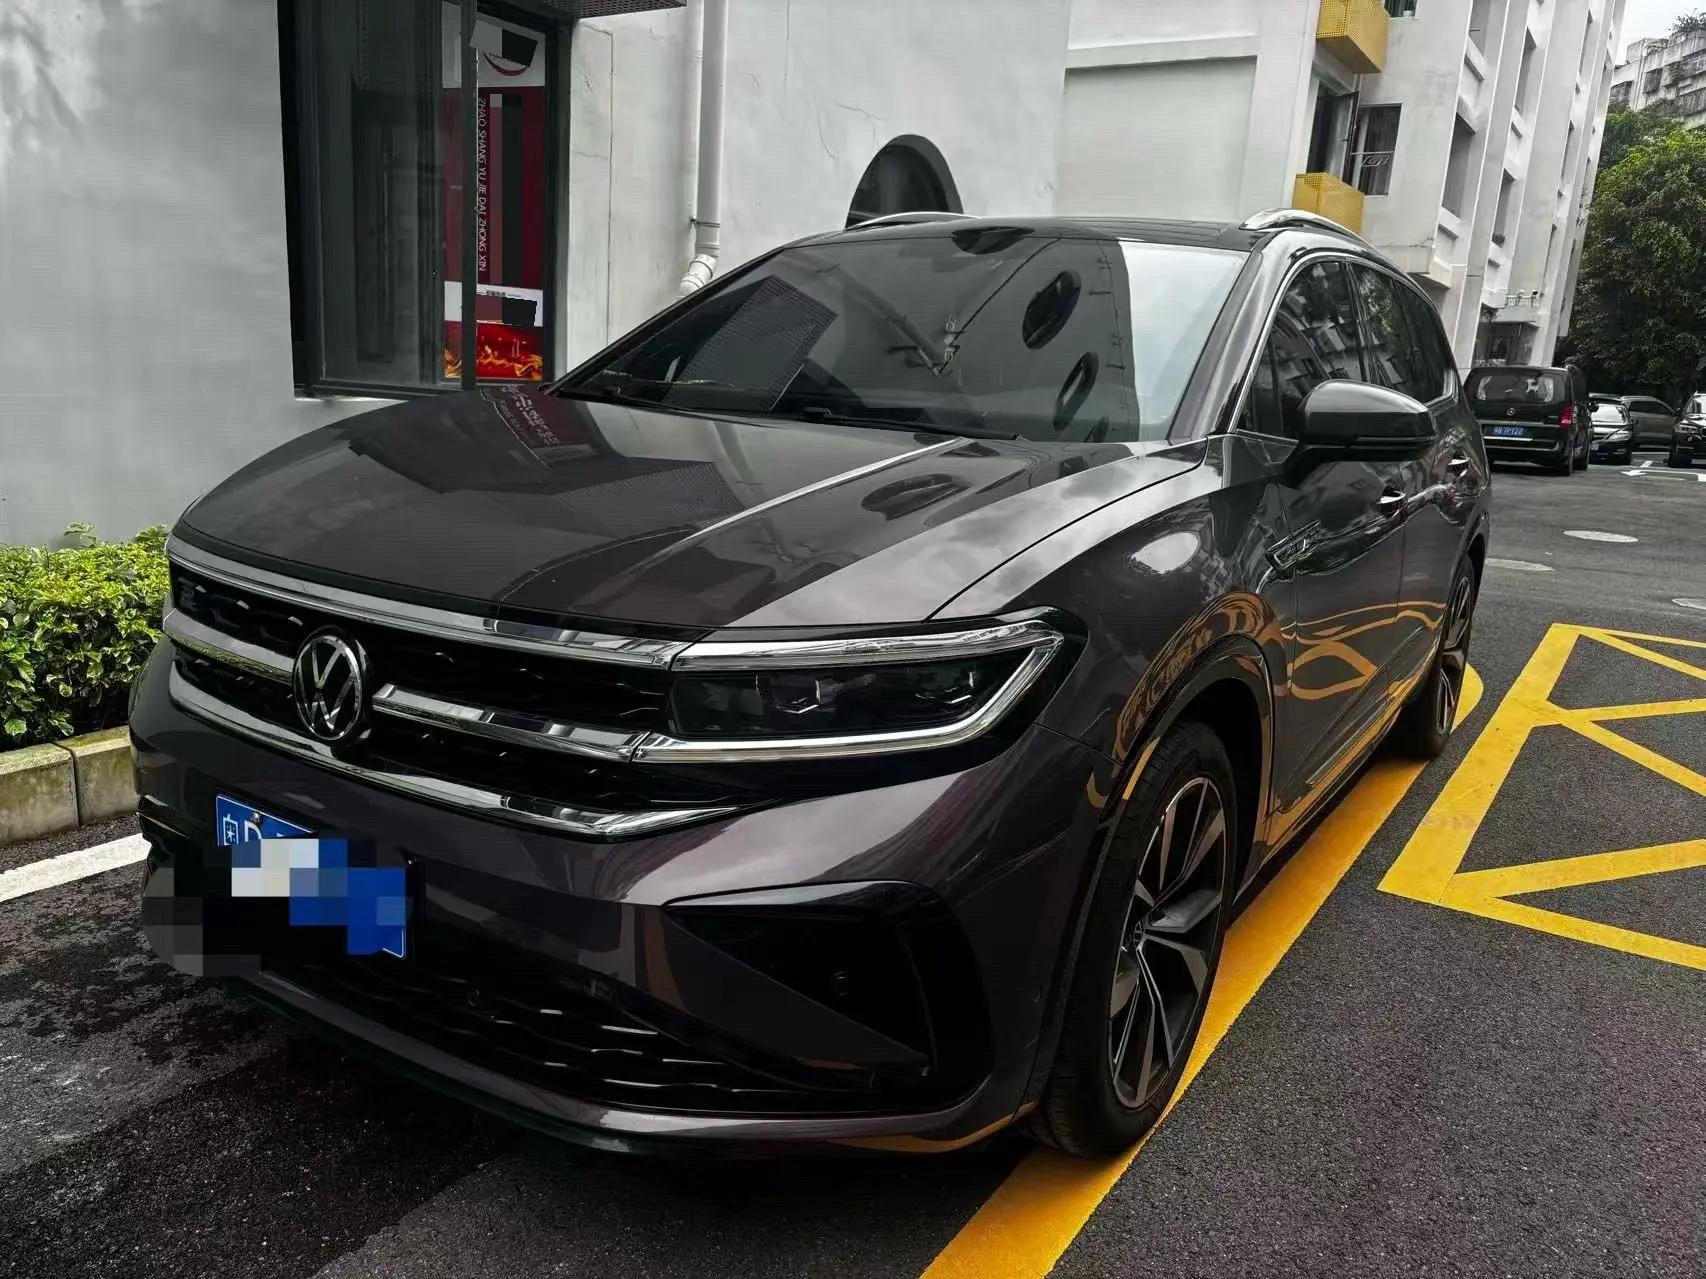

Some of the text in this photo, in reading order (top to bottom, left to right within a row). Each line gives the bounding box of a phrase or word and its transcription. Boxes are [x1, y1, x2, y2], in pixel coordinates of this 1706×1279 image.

[478, 97, 487, 127] ZHAO
[478, 129, 487, 164] SHANG
[478, 167, 487, 180] YU
[478, 197, 487, 215] DAI
[478, 218, 487, 252] ZHONG
[479, 254, 487, 271] XIN
